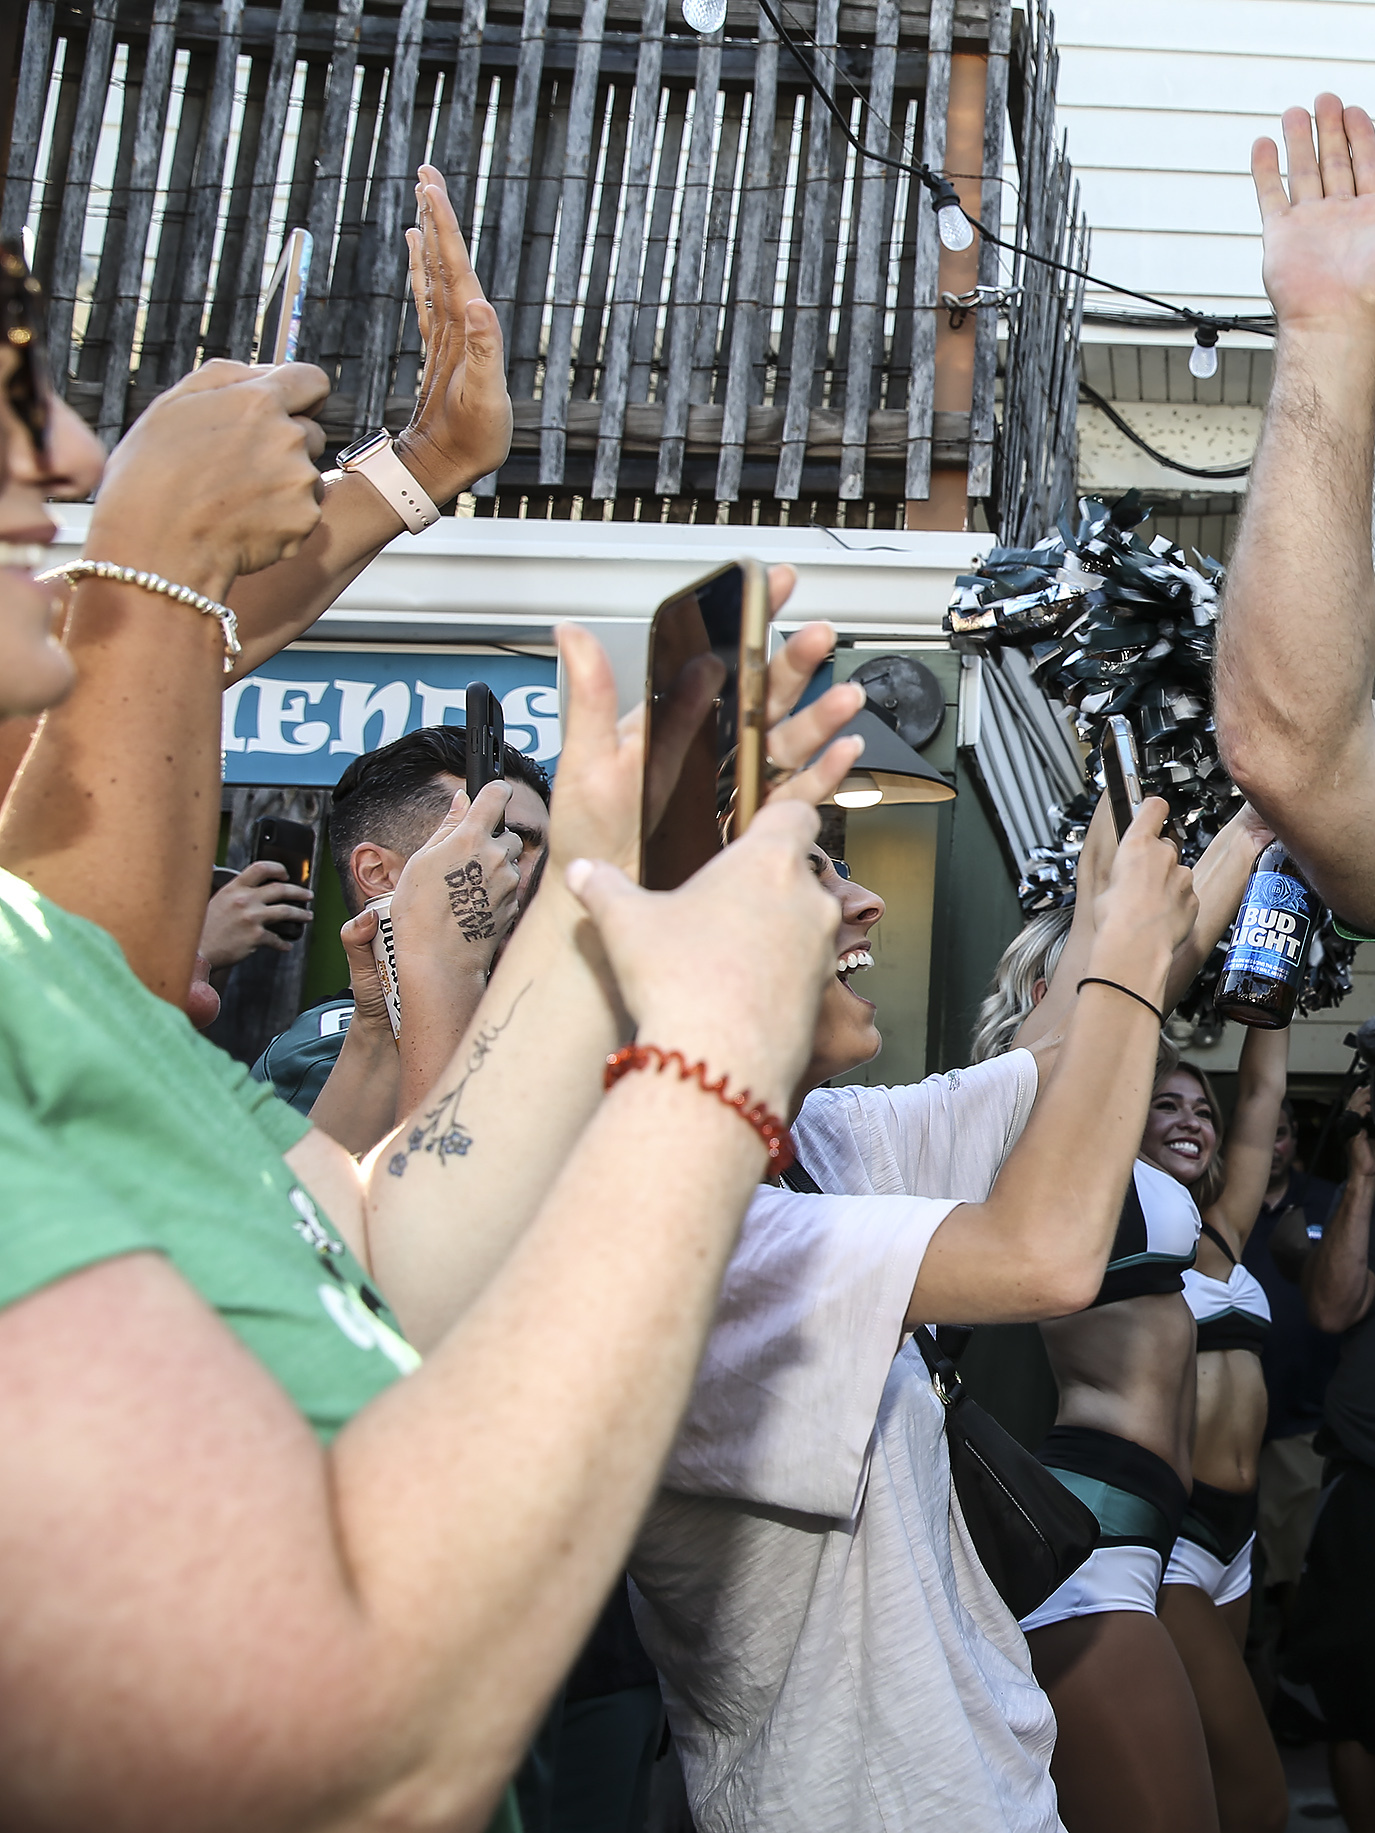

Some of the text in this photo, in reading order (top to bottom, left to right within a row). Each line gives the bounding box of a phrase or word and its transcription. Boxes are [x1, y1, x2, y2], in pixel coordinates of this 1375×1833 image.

[444, 867, 483, 943] DRIVE
[465, 860, 497, 939] OCEAN
[1241, 907, 1297, 934] BUD
